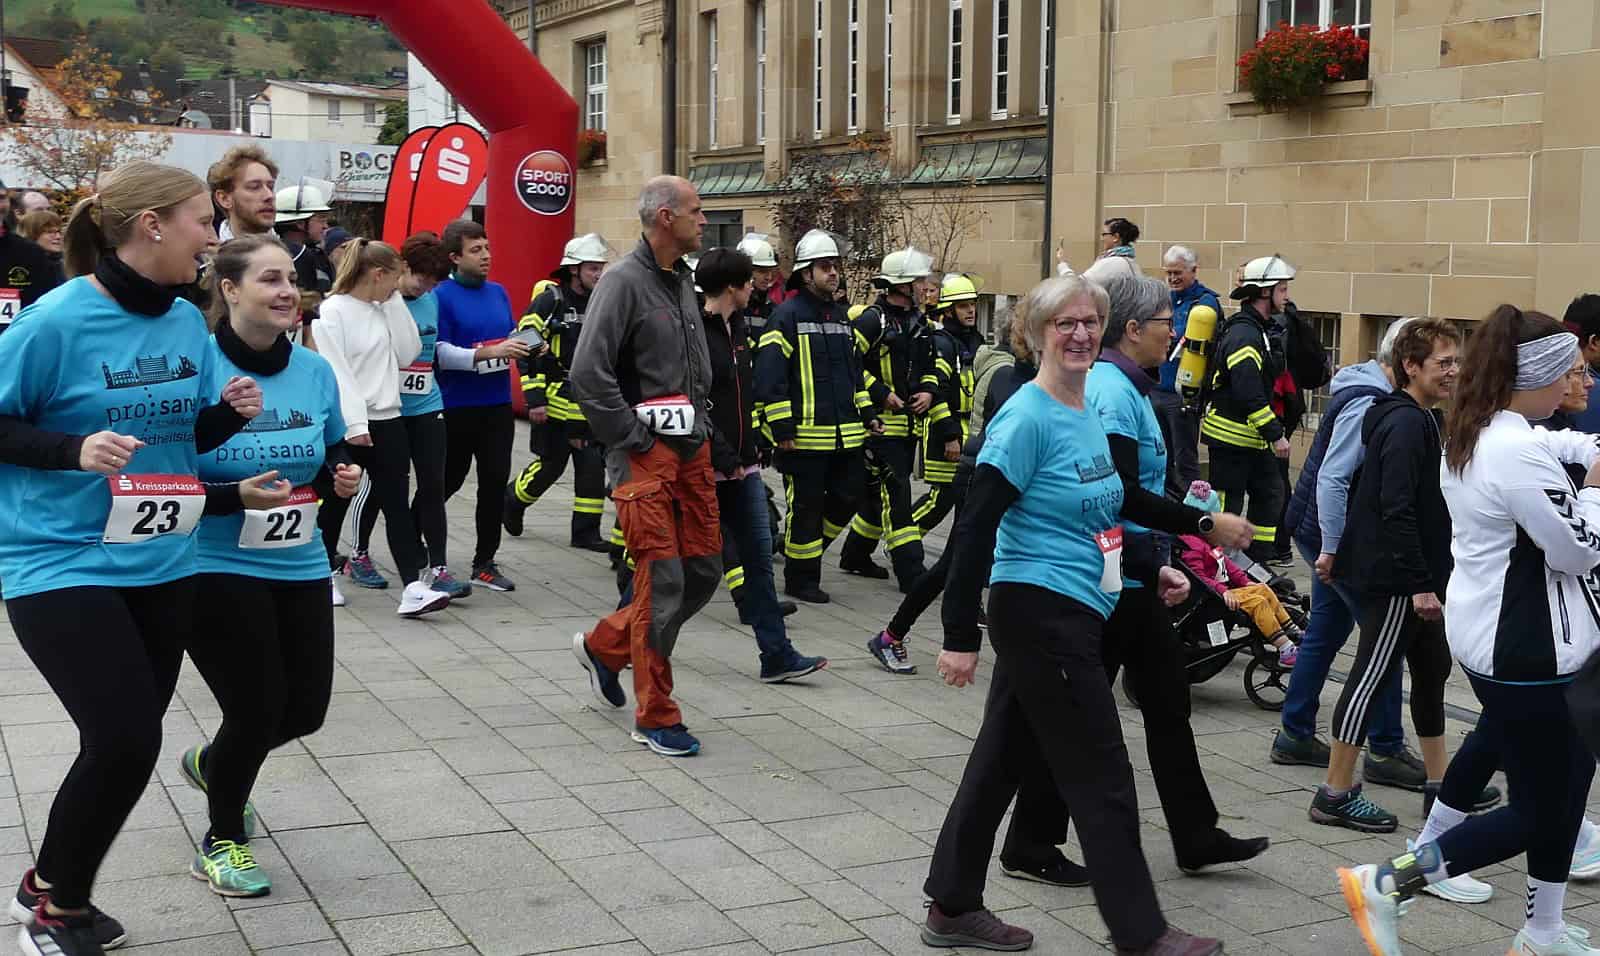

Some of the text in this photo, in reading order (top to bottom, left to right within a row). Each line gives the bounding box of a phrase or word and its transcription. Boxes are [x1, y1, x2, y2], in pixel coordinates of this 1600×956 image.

[340, 151, 395, 170] BOC
[522, 169, 569, 184] SPORT
[526, 182, 566, 197] 2000
[403, 374, 425, 391] 46
[646, 407, 686, 430] 121
[135, 481, 199, 493] Kreissparkasse
[131, 500, 181, 535] 23
[264, 508, 302, 541] 22
